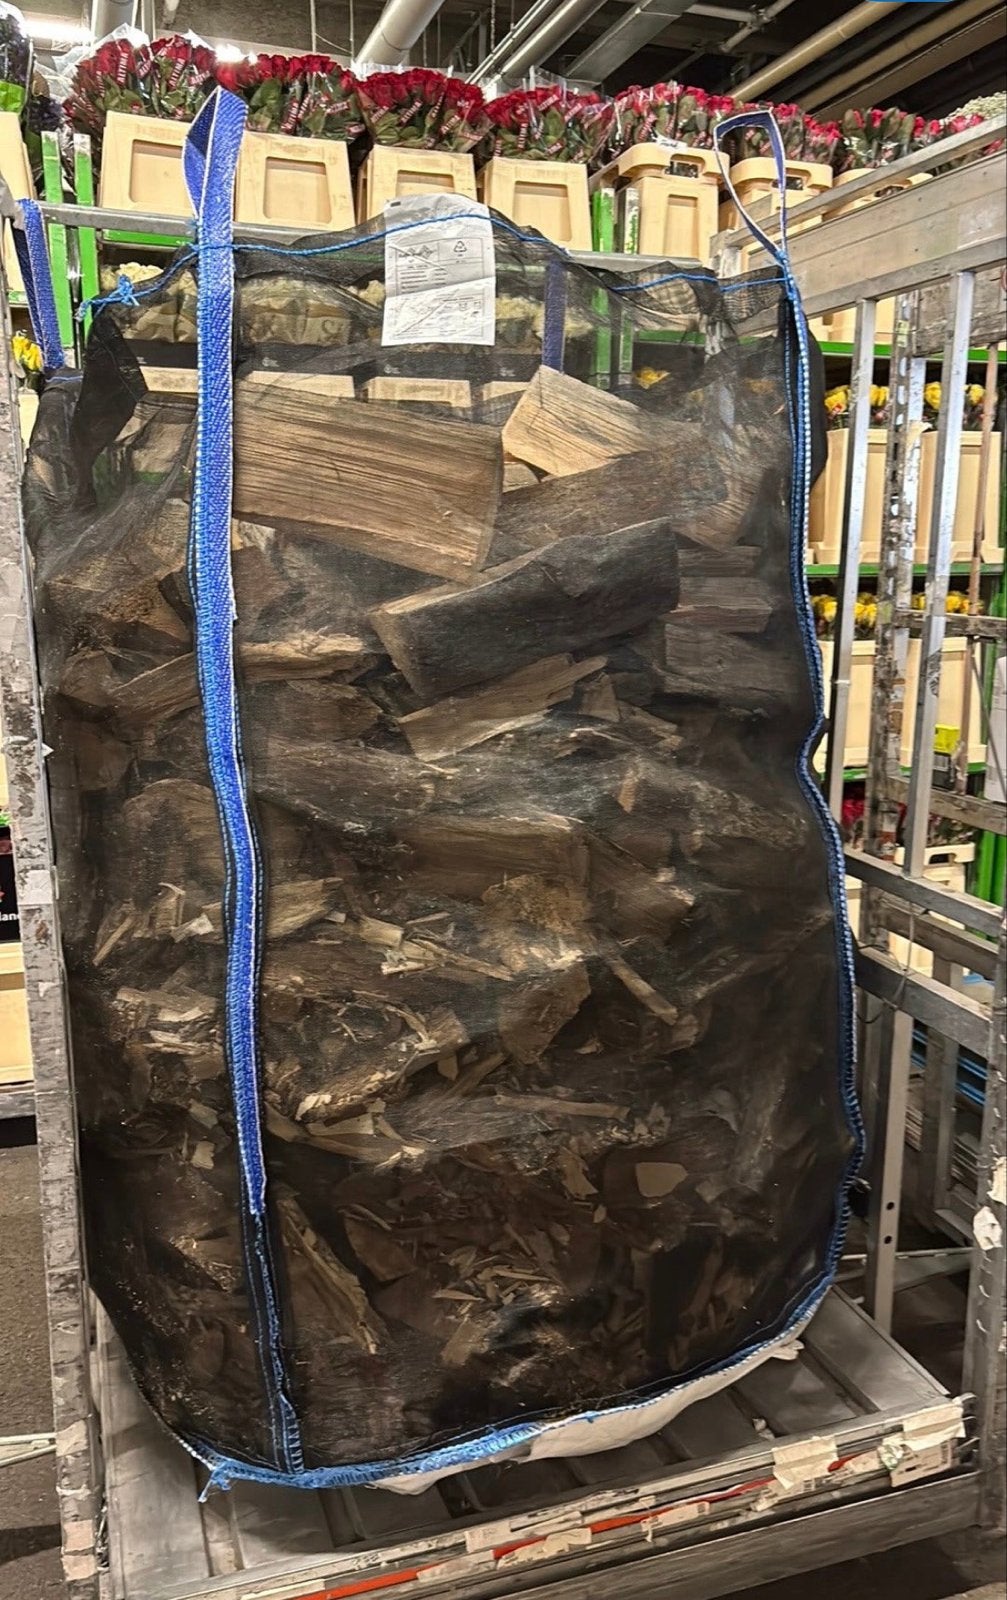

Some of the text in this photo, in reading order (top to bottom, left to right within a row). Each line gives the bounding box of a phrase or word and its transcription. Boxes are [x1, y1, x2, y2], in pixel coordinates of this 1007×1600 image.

[117, 52, 128, 83] ALTIMA
[168, 58, 185, 87] ALTIMA
[401, 101, 421, 124] ALTIMA
[518, 122, 528, 149] ALTIMA
